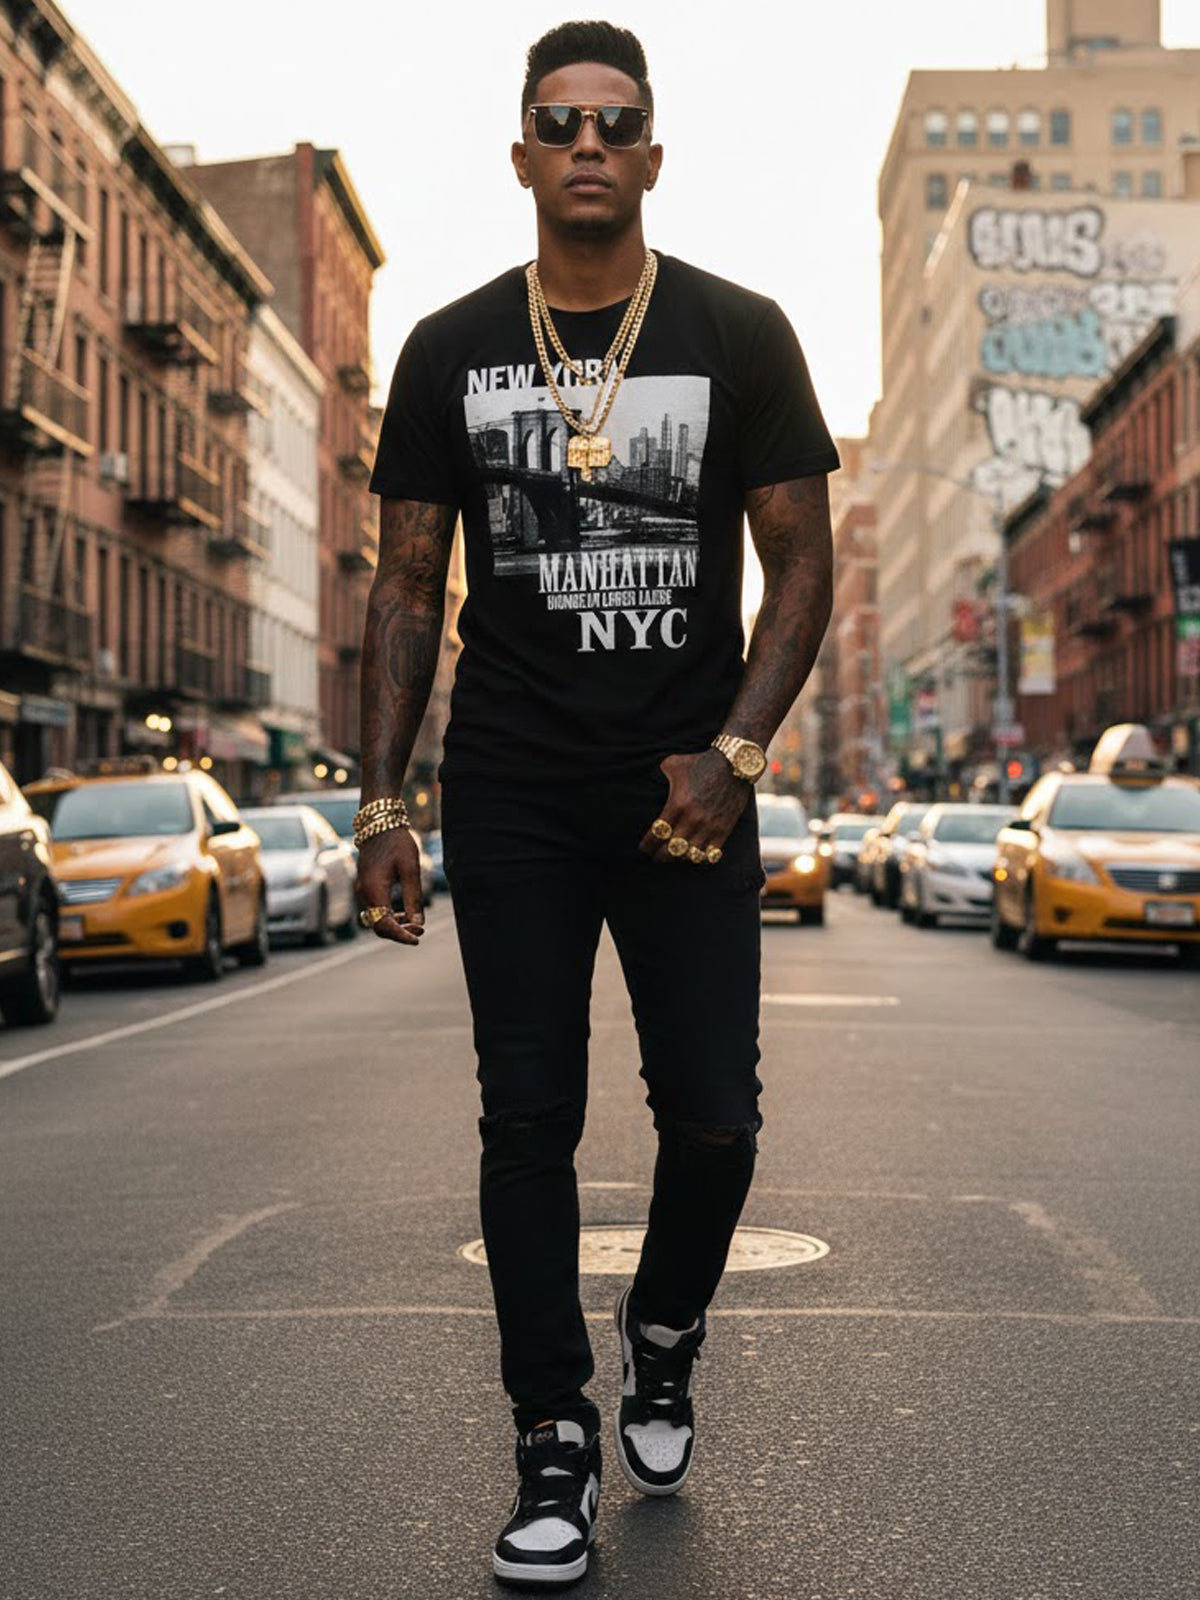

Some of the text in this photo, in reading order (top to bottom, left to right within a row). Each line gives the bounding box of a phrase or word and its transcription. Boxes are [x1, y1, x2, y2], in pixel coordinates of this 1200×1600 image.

[467, 364, 535, 395] NEW
[538, 549, 697, 593] MANHATTAN
[576, 608, 687, 652] NYC
